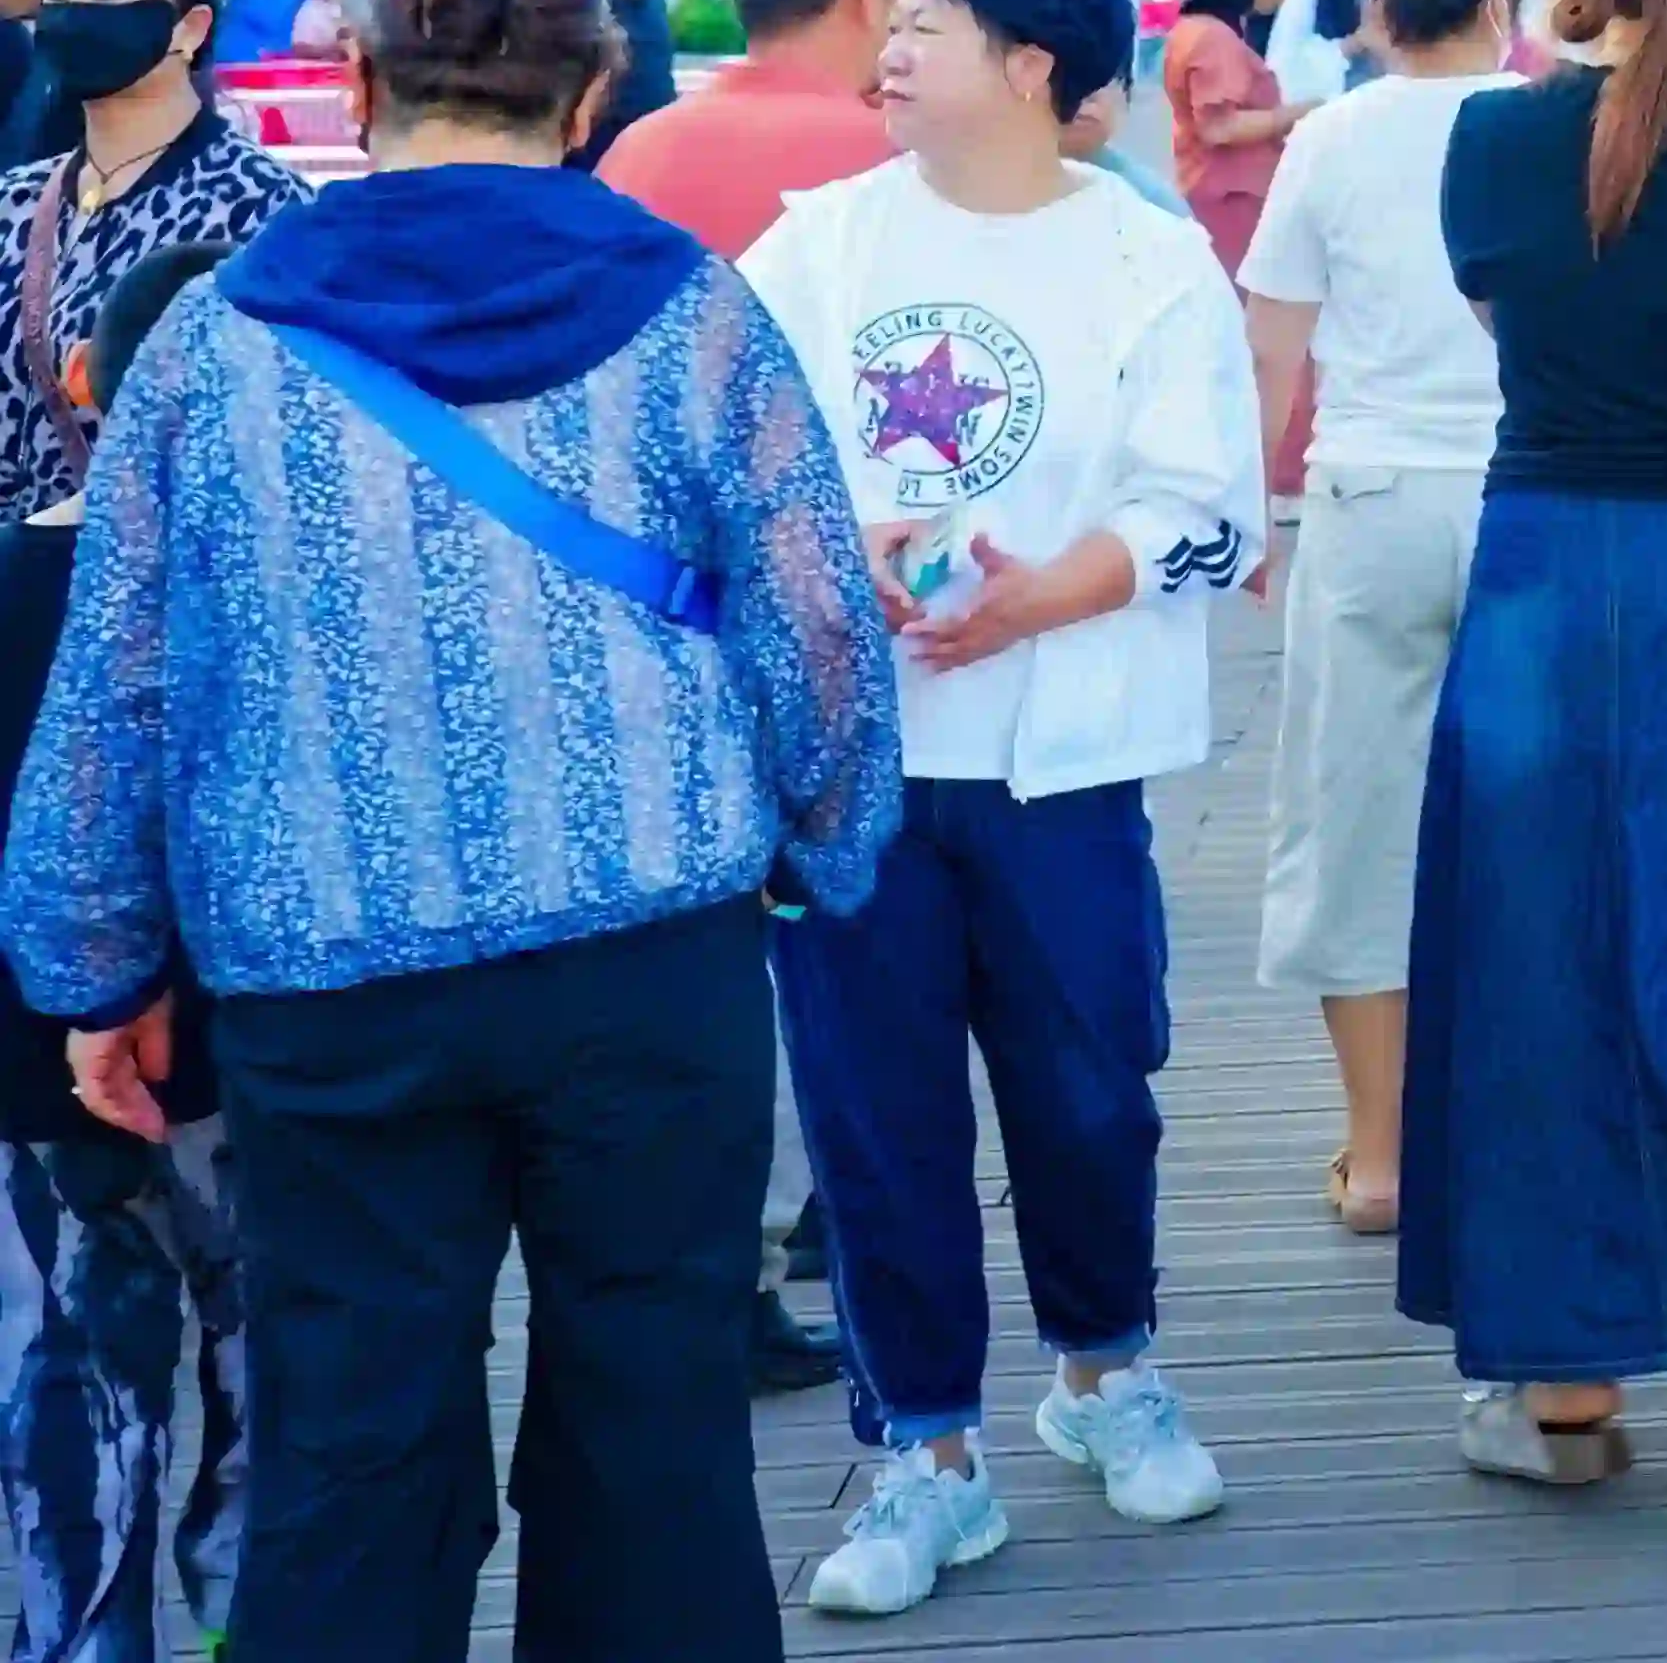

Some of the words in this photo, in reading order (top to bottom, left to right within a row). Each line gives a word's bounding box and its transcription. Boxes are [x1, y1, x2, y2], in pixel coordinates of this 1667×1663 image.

[851, 309, 942, 361] EELING
[1006, 394, 1034, 445] WIN
[943, 445, 1012, 496] SOME
